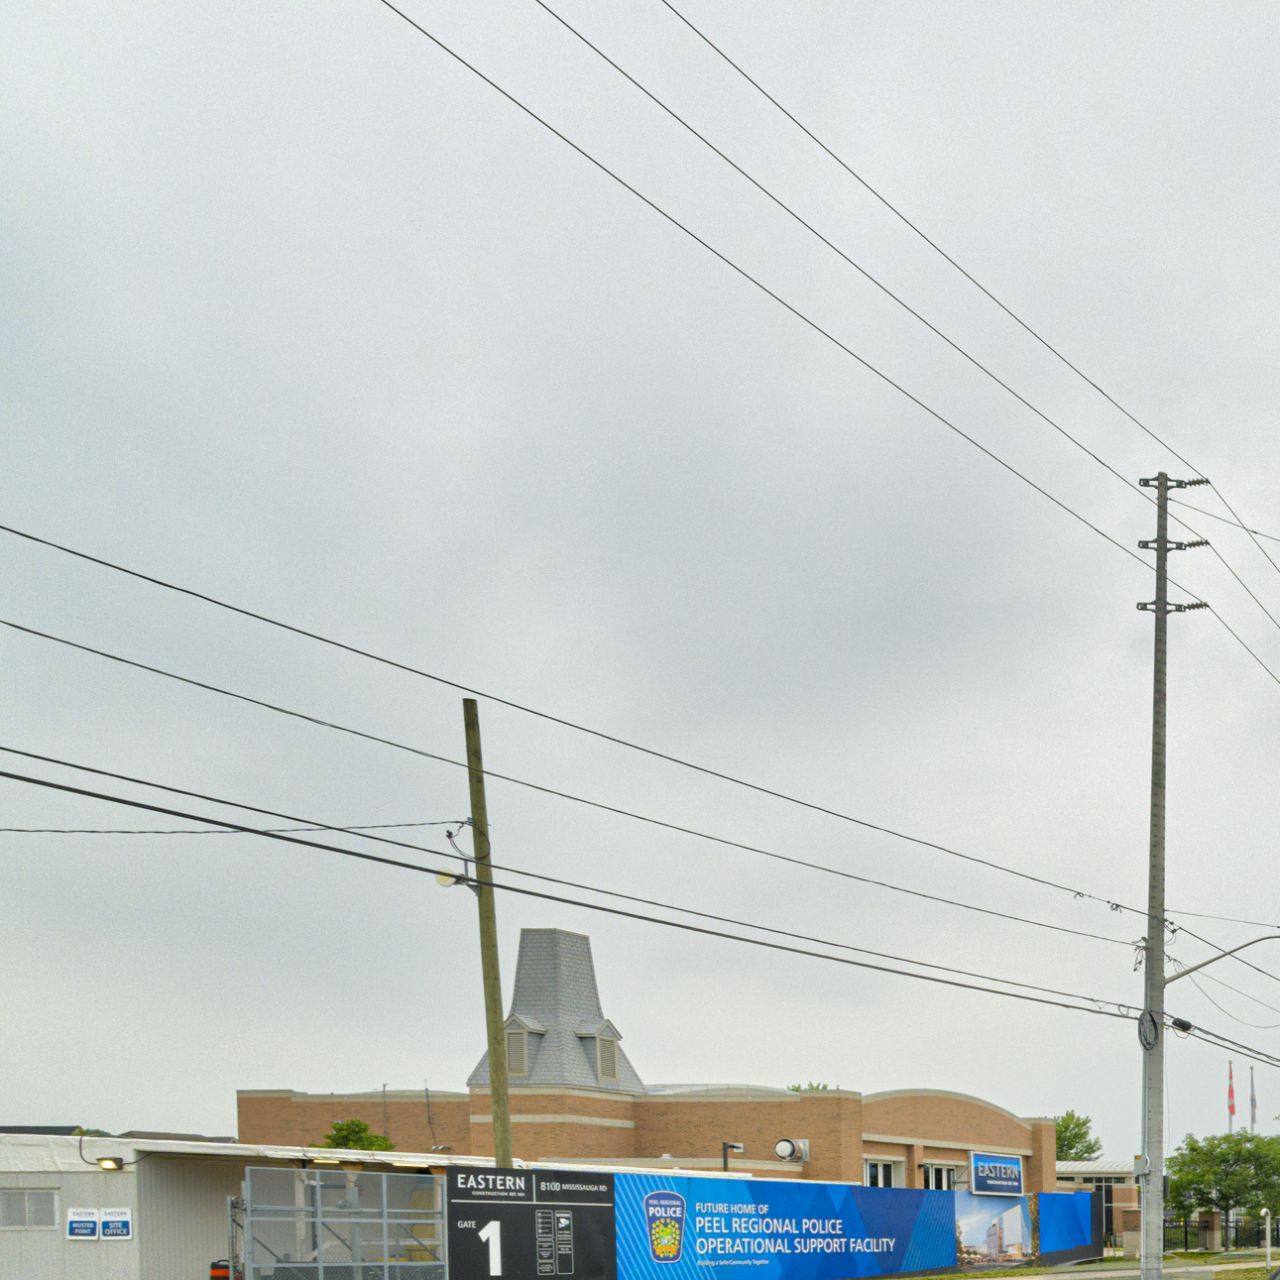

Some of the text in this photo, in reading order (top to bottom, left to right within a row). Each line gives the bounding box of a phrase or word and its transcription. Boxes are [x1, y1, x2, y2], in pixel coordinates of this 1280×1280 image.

[978, 1161, 1019, 1179] EASTERN
[457, 1174, 526, 1190] EASTERN
[540, 1182, 560, 1191] 8100
[561, 1183, 599, 1192] MISSISSAUGA
[648, 1206, 682, 1217] POLICE
[695, 1202, 769, 1215] FUTURE HOME OF
[457, 1220, 477, 1229] GATE
[696, 1217, 843, 1234] PEEL REGIONAL POLICE
[478, 1220, 502, 1276] 1
[696, 1237, 896, 1254] OPERATIONAL SUPPORT FACILITY
